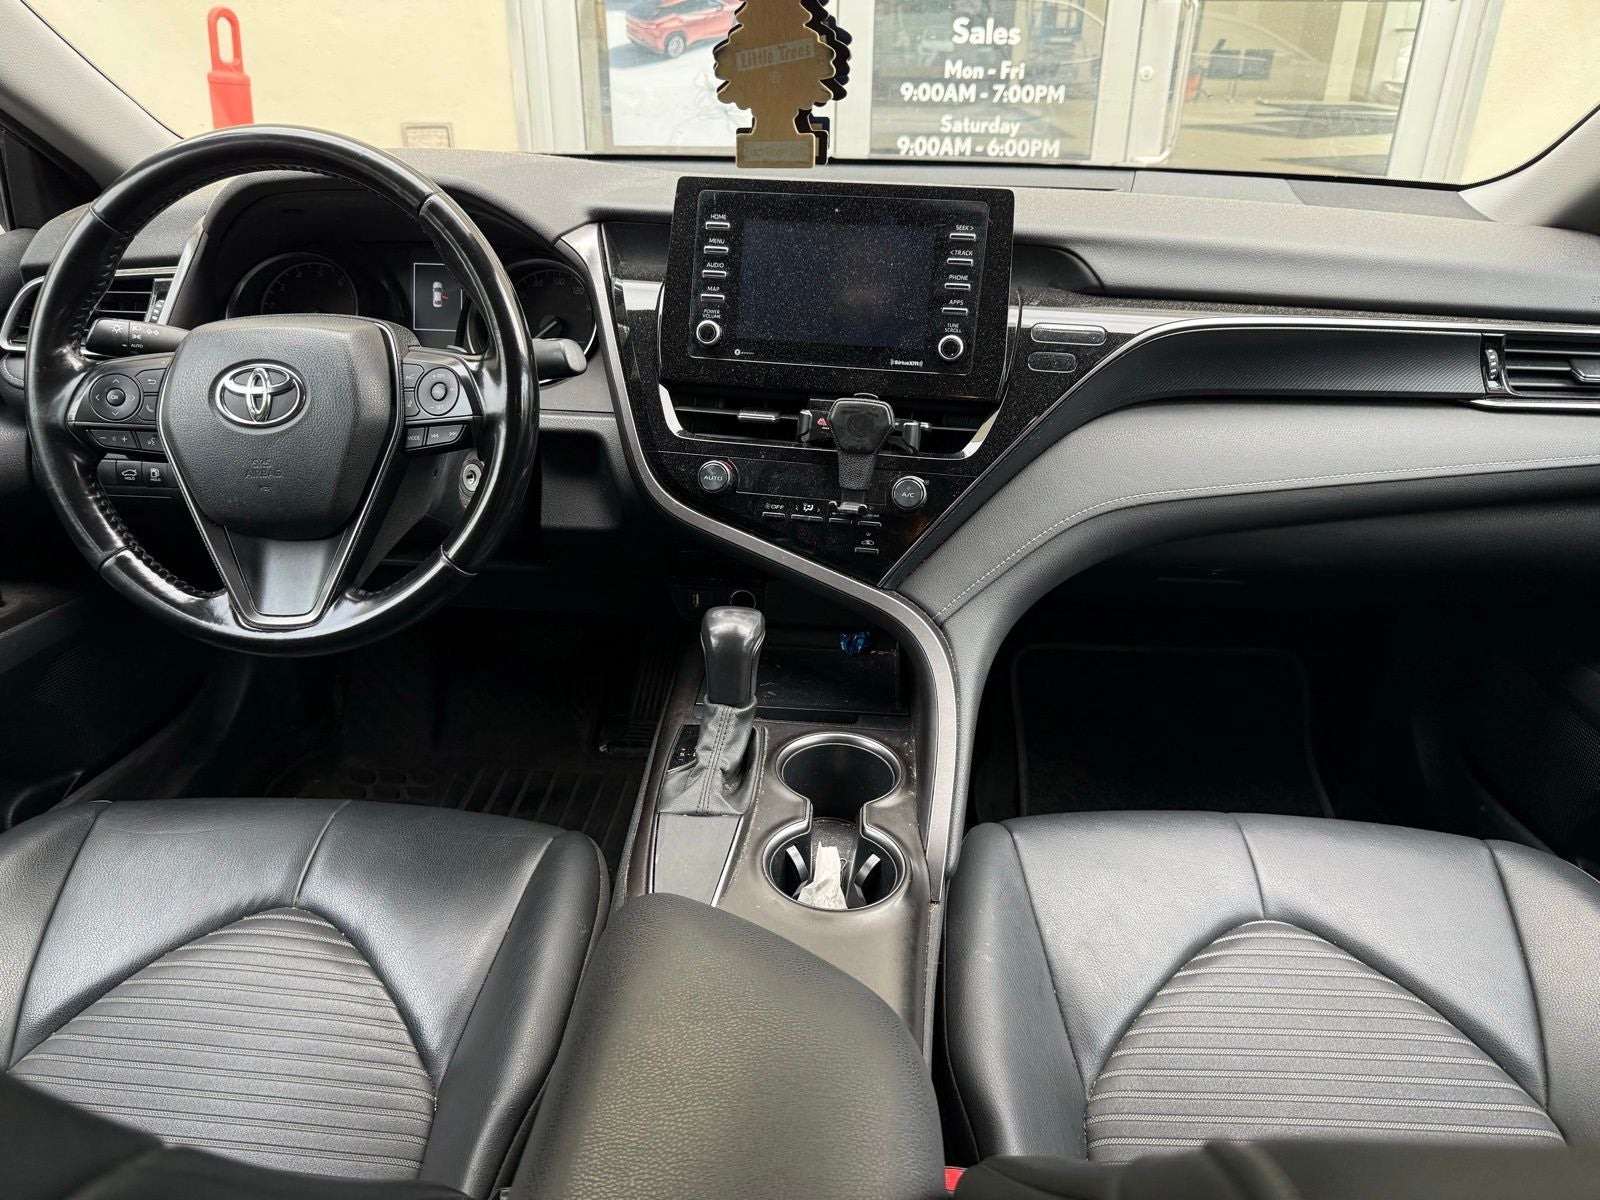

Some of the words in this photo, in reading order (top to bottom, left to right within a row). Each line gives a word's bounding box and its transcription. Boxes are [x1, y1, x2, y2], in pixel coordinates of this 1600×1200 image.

[952, 16, 1021, 45] Sales
[944, 59, 985, 79] Mon
[1000, 60, 1026, 80] Fri
[900, 82, 976, 103] 9:00AM
[992, 84, 1066, 104] 7:00PM
[940, 114, 1021, 137] Saturday
[896, 135, 972, 156] 9:00AM
[986, 138, 1060, 158] 6:00PM
[244, 469, 282, 479] AIRBAG
